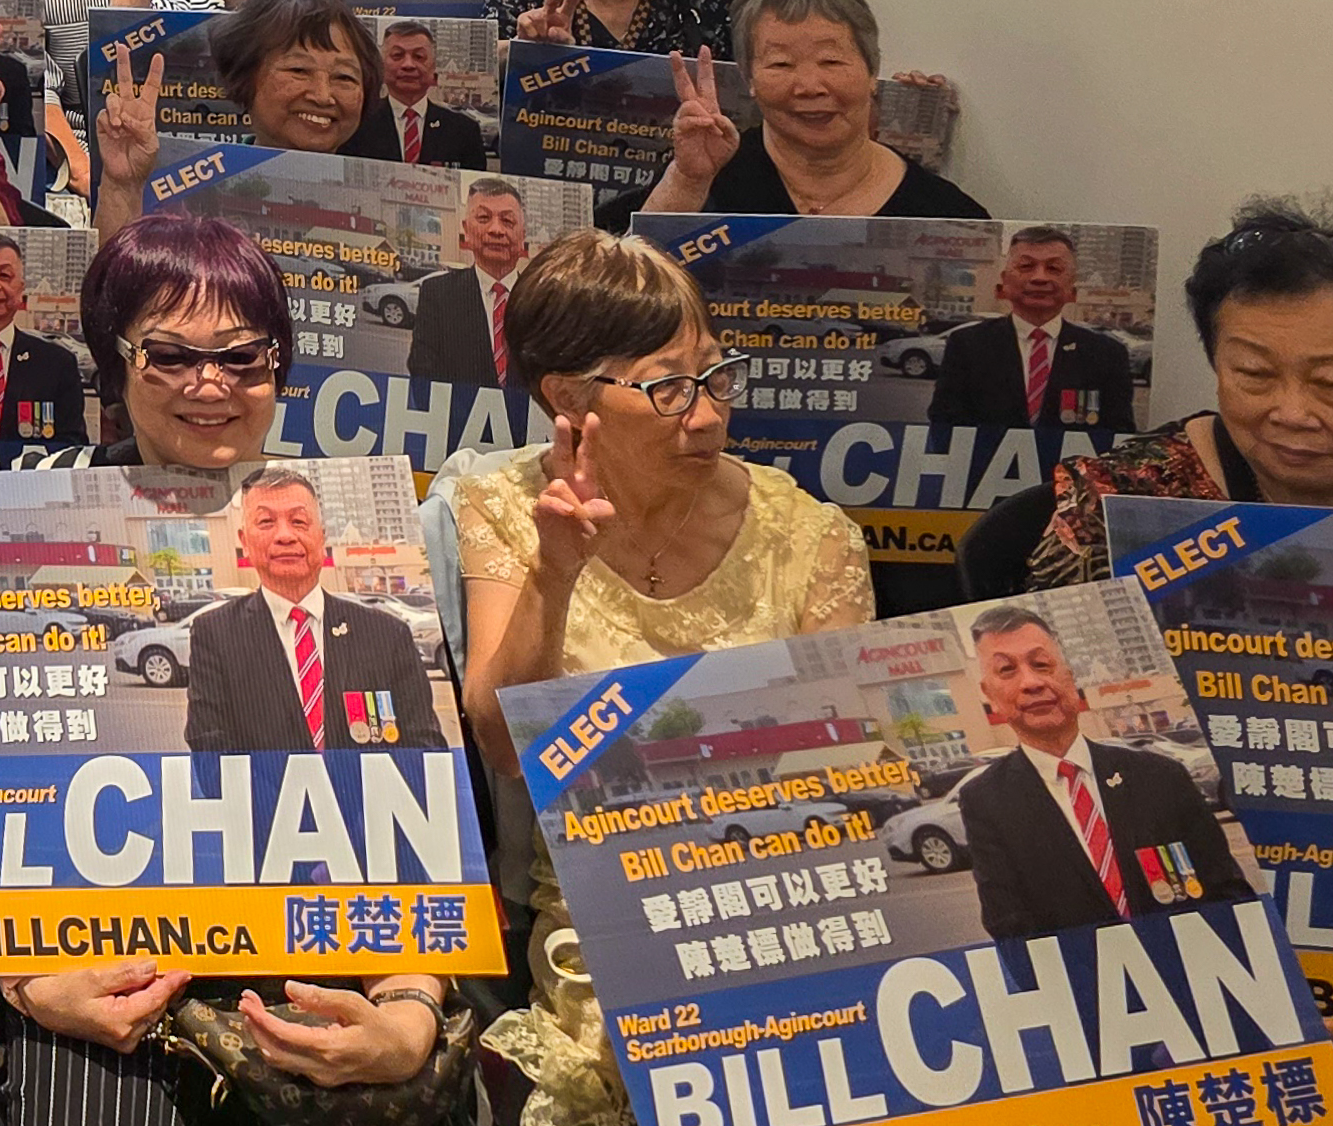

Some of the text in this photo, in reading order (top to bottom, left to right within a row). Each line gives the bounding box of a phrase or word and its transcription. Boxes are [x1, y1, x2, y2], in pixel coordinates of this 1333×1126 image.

[518, 56, 593, 93] ELECT
[516, 107, 602, 134] Agincourt
[150, 151, 227, 202] ELECT
[339, 242, 400, 271] better,
[311, 270, 334, 293] do
[755, 299, 926, 326] deserves better,
[823, 332, 849, 351] do
[1132, 516, 1248, 592] ELECT
[76, 580, 161, 612] better,
[41, 625, 75, 653] do
[79, 623, 108, 652] it!
[857, 634, 948, 664] AGINCOURT
[886, 655, 925, 676] MALL
[1194, 669, 1331, 708] Bill Chan
[540, 680, 631, 783] ELECT
[560, 752, 923, 846] Agincourt deserves better,
[63, 751, 463, 887] CHAN
[619, 809, 879, 884] Bill Chan can do it!
[639, 854, 895, 934] 愛靜閣可以更好
[285, 893, 475, 955] 陳楚標
[674, 906, 896, 982] 陳楚標做得到
[617, 1002, 703, 1039] Ward 22
[881, 900, 1307, 1105] CHAN
[623, 999, 870, 1067] Scarborough-Agincourt
